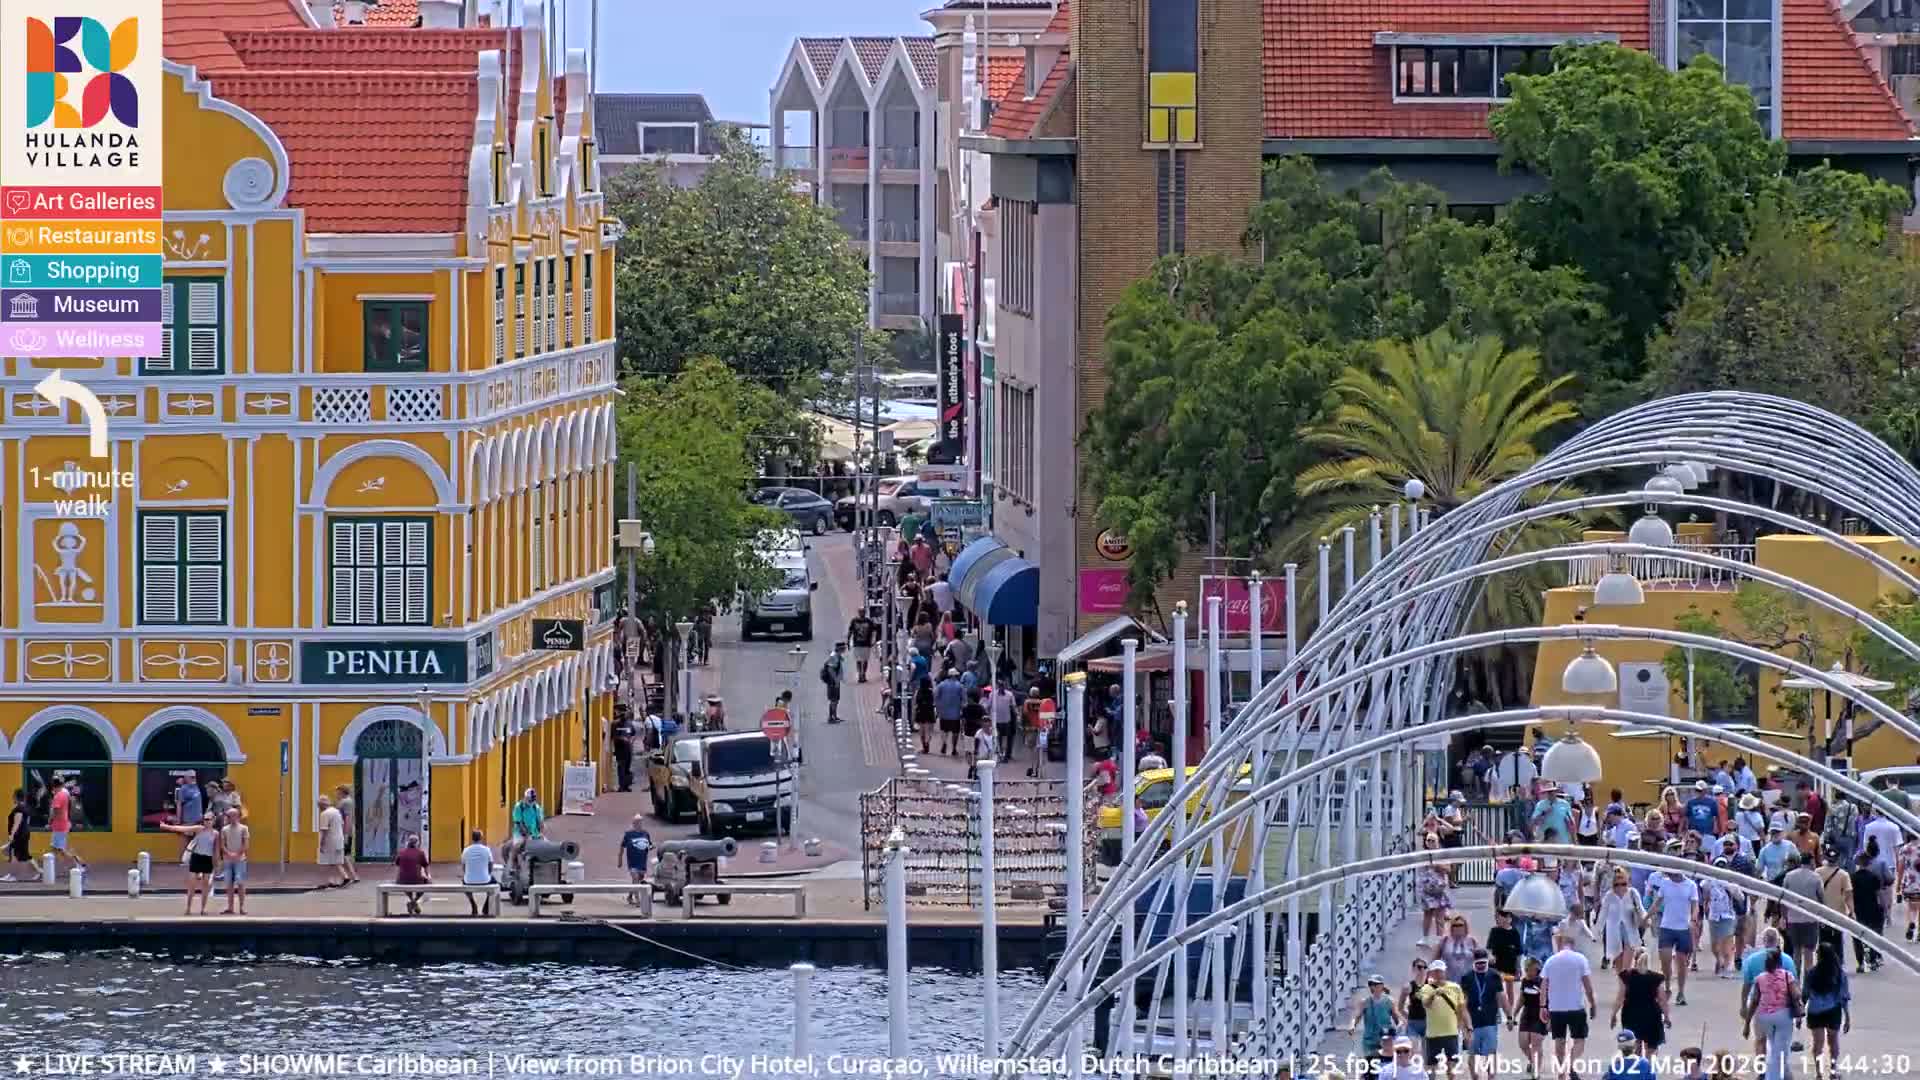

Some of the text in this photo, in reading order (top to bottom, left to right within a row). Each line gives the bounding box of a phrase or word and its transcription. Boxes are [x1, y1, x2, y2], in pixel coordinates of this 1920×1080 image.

[948, 332, 958, 355] foot
[948, 420, 958, 439] the
[325, 650, 444, 675] PENHA
